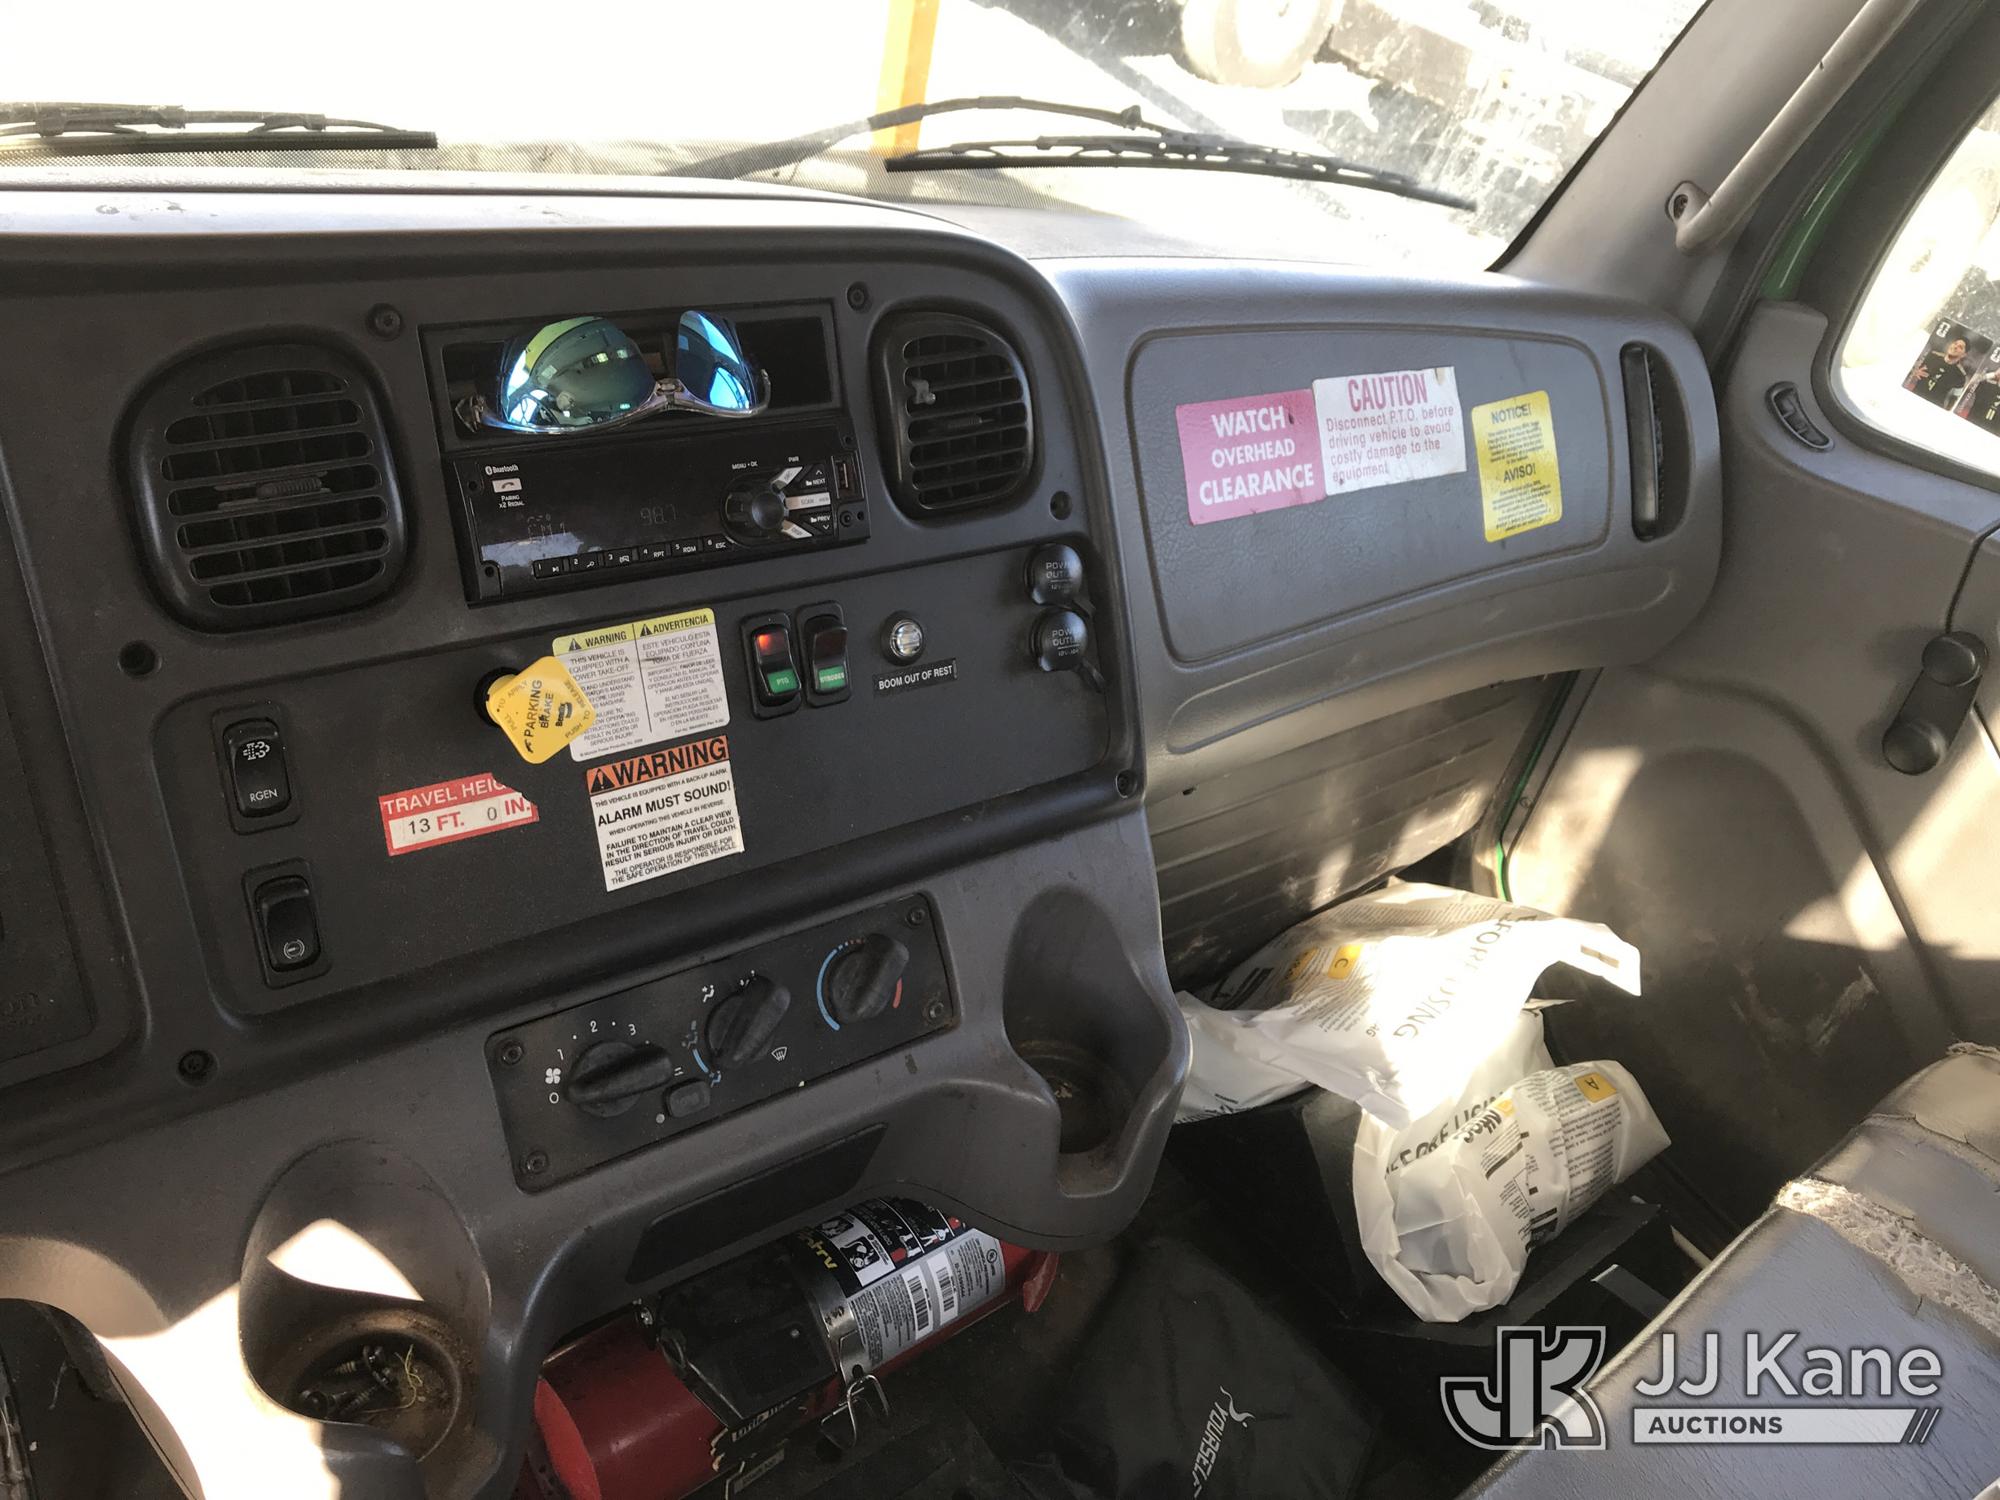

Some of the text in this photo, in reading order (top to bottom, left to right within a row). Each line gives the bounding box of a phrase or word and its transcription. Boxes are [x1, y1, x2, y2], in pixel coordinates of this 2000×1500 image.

[1348, 373, 1428, 412] CAUTION
[1212, 406, 1285, 437] WATCH
[1326, 405, 1454, 432] Disconnect P.T.O. before
[1492, 403, 1532, 424] NOTICE!
[1328, 421, 1451, 449] driving vehicle to avoid
[1211, 438, 1295, 469] OVERHEAD
[1330, 438, 1441, 466] costly damage to the
[493, 465, 519, 474] Bluetooth
[1332, 461, 1389, 482] equipment
[1503, 463, 1536, 483] AVISO!
[1199, 463, 1314, 505] CLEARANCE
[653, 614, 708, 634] ADVERTENCIA
[585, 631, 627, 648] WARNING
[570, 656, 587, 666] THIS
[588, 650, 616, 662] VEHICLE
[776, 677, 789, 685] PTO
[879, 665, 952, 690] BOOM OUT OF REST
[524, 680, 542, 737] PARKING
[540, 693, 553, 728] BRAKE
[565, 723, 583, 738] PUSH
[612, 738, 727, 786] WARNING
[250, 788, 278, 801] RGEN
[383, 787, 457, 815] TRAVEL
[609, 794, 631, 804] VEHICLE
[639, 784, 665, 796] EQUIPPED
[686, 773, 708, 784] BACK-UP
[408, 797, 530, 835] 13 FT. 0 IN.
[597, 781, 731, 826] ALARM MUST SOUND!
[607, 837, 636, 850] FAILURE
[649, 824, 683, 838] MAINTAIN
[691, 815, 714, 827] CLEAR
[715, 810, 732, 820] VIEW
[609, 827, 626, 836] WHEN
[627, 818, 657, 831] OPERATING
[659, 814, 670, 822] THIS
[672, 808, 693, 819] VEHICLE
[605, 854, 632, 867] RESULT
[634, 851, 641, 859] IN
[643, 842, 674, 856] SERIOUS
[676, 835, 700, 847] INJURY
[703, 831, 712, 839] OR
[607, 817, 734, 859] IN THE DIRECTION OF TRAVEL COULD
[612, 875, 625, 884] THE
[627, 870, 643, 880] SAFE
[645, 858, 682, 875] OPERATION
[684, 855, 692, 863] OF
[695, 851, 709, 860] THIS
[615, 867, 628, 876] THE
[629, 856, 665, 872] OPERATOR
[675, 841, 717, 859] RESPONSIBLE
[720, 837, 732, 846] FOR
[590, 1020, 598, 1033] 2
[628, 1024, 636, 1035] 3
[557, 1049, 564, 1060] 1
[1584, 1076, 1599, 1091] A
[549, 1092, 559, 1104] 0
